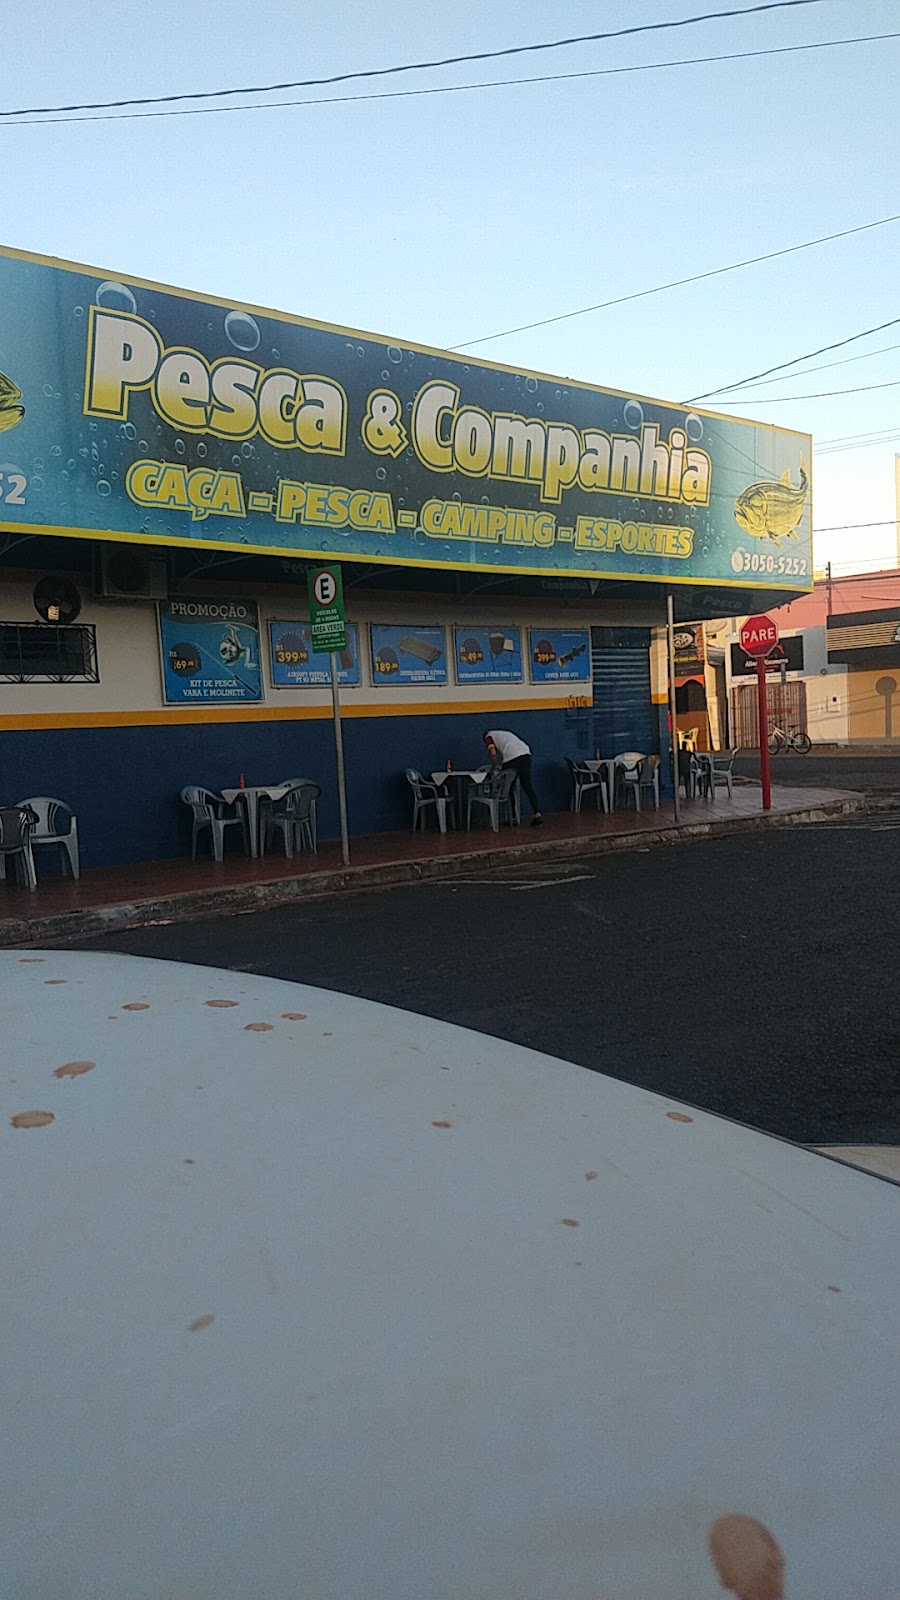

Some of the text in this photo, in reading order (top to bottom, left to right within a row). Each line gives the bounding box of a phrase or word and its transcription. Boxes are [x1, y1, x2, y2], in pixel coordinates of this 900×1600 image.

[84, 305, 712, 507] Pesca & Companhia
[0, 472, 27, 505] 2
[126, 459, 247, 520] CAÇA
[276, 480, 396, 534] PESCA
[420, 498, 556, 548] CAMPING
[574, 515, 696, 560] ESPORTES
[742, 553, 807, 576] 3050-5252
[320, 577, 330, 600] E
[170, 602, 247, 620] PROMOÇÃO
[742, 626, 775, 644] PARE
[183, 689, 202, 697] VARA
[209, 689, 246, 697] MOLINETE
